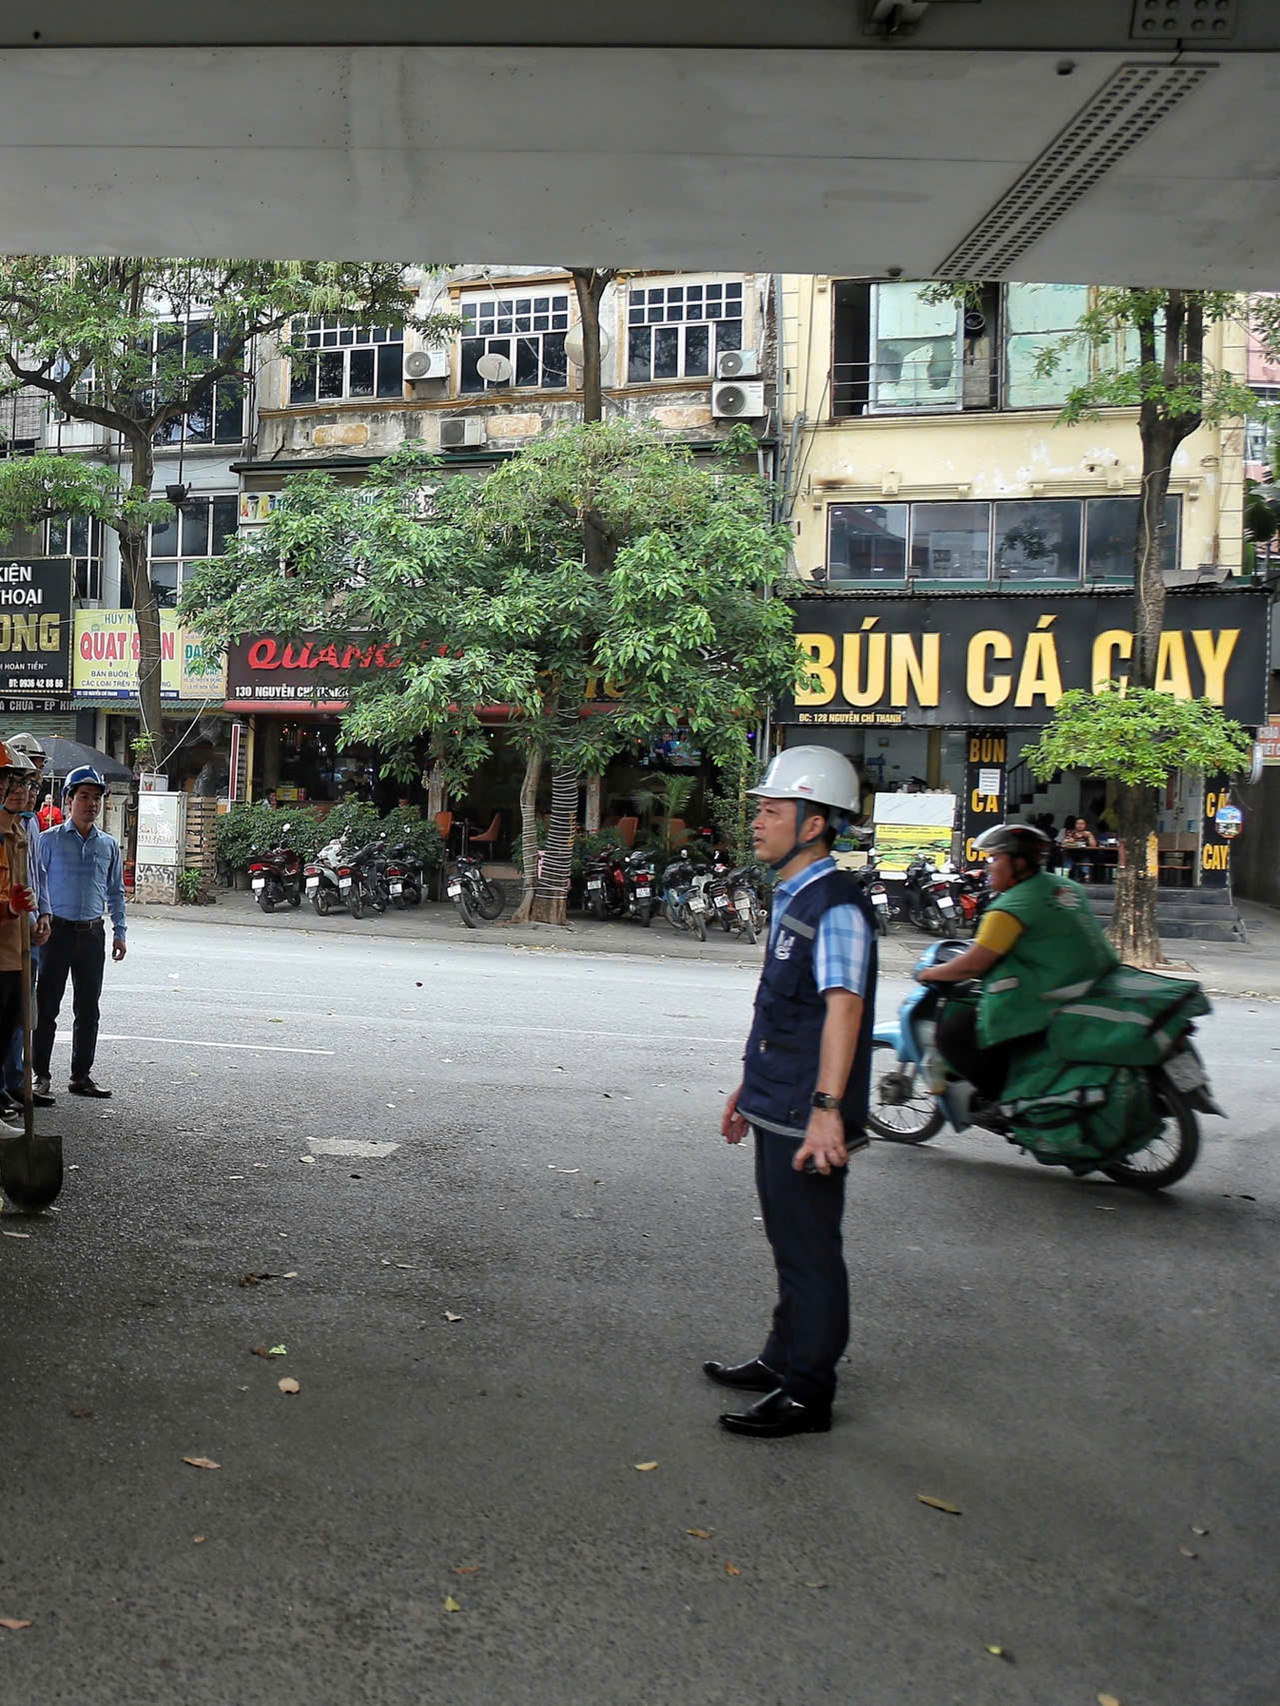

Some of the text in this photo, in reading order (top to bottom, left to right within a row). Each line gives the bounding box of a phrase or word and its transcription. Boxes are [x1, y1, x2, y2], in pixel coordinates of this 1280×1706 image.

[105, 614, 123, 624] HUY
[80, 631, 127, 667] QUẠT
[794, 614, 1241, 708] BÚN CÁ CAY
[235, 686, 252, 697] 130
[255, 683, 295, 697] NGUYỄN
[814, 713, 827, 723] 128
[875, 713, 902, 723] THANH
[969, 734, 1006, 762] BÚN
[1202, 843, 1230, 870] CAY
